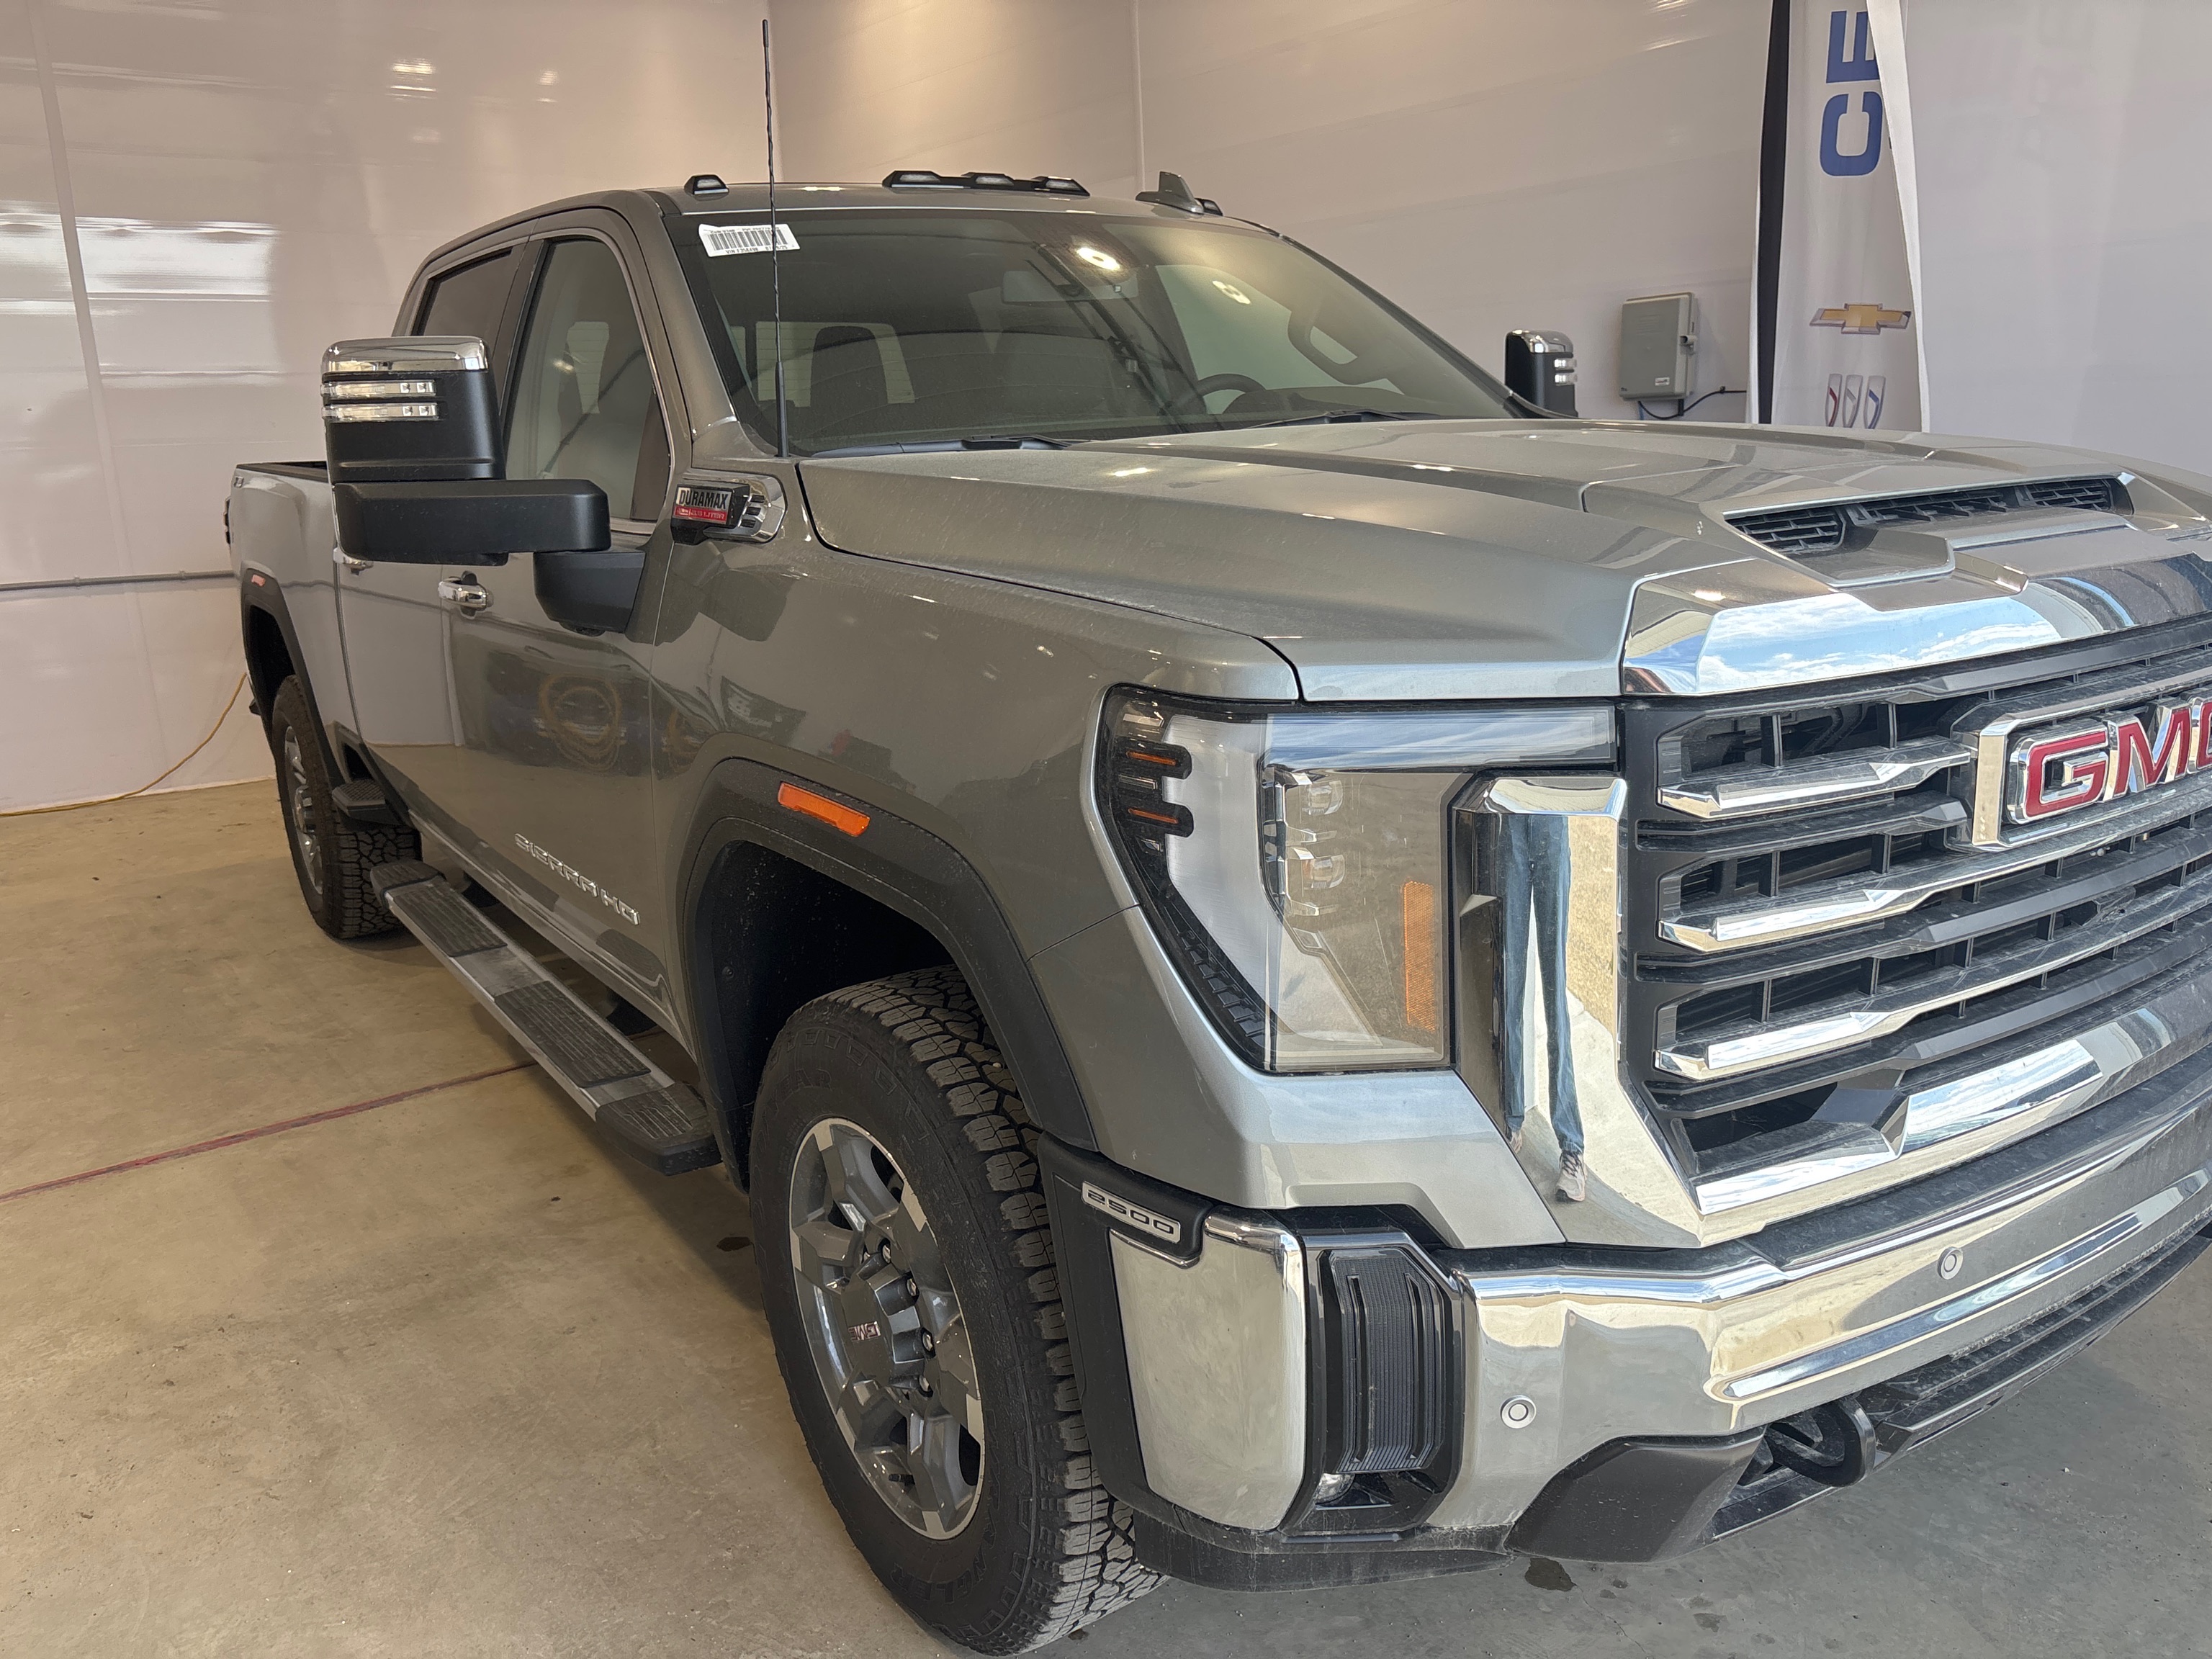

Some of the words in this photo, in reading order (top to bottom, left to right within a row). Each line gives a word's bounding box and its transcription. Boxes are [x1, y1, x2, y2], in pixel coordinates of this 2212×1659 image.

[679, 490, 729, 509] DURAMAX
[2010, 696, 2212, 824] GM
[514, 832, 600, 898] SIERRA
[601, 888, 641, 925] HD
[1086, 1189, 1174, 1235] 2500
